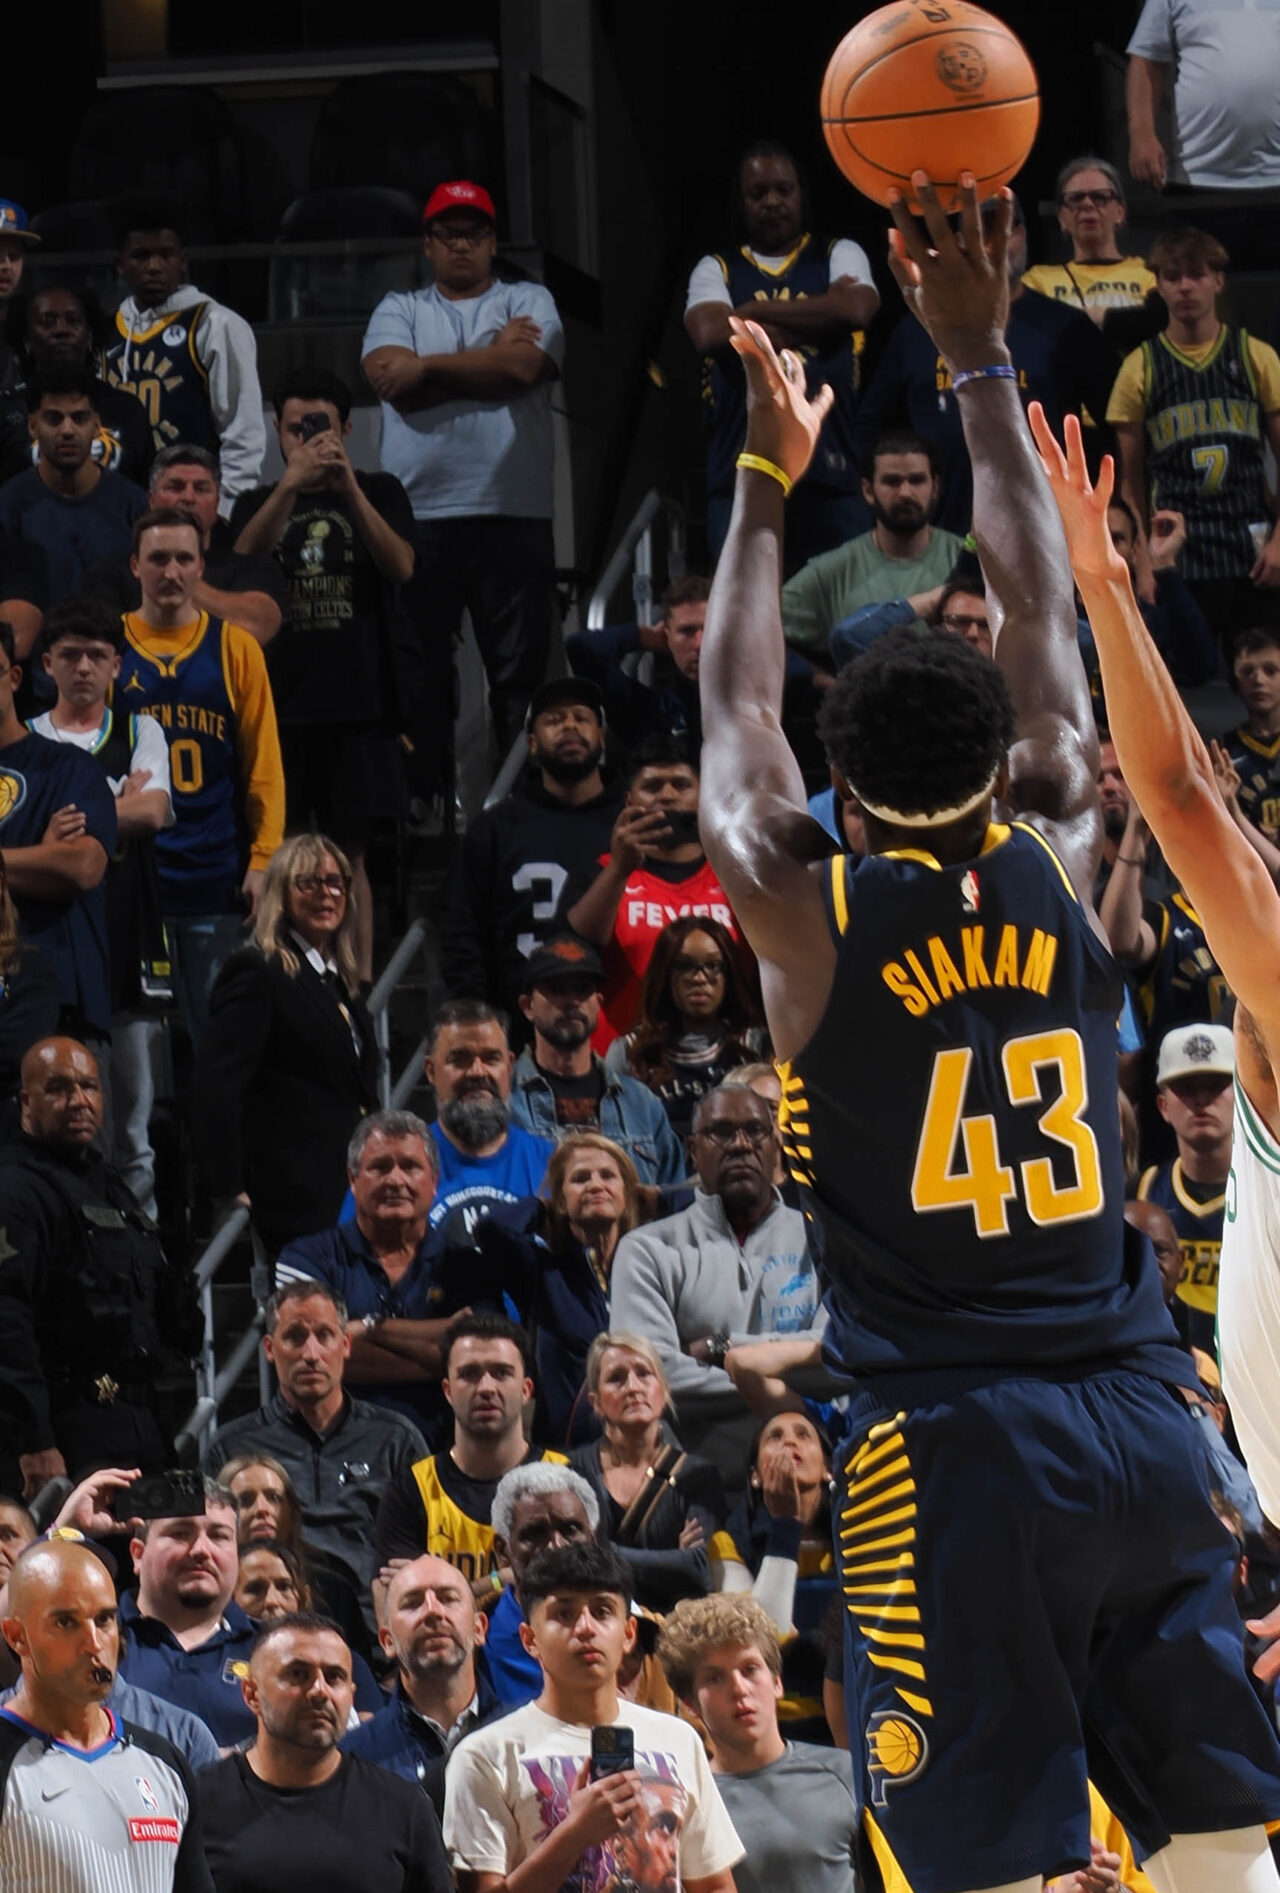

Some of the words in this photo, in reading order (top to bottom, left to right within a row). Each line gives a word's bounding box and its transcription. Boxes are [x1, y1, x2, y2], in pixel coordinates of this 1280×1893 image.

[1191, 444, 1228, 496] 7
[175, 703, 228, 743] STATE
[512, 862, 569, 960] 3
[627, 900, 734, 929] FEVER
[881, 924, 1058, 1018] SIAKAM
[911, 1028, 1104, 1239] 43
